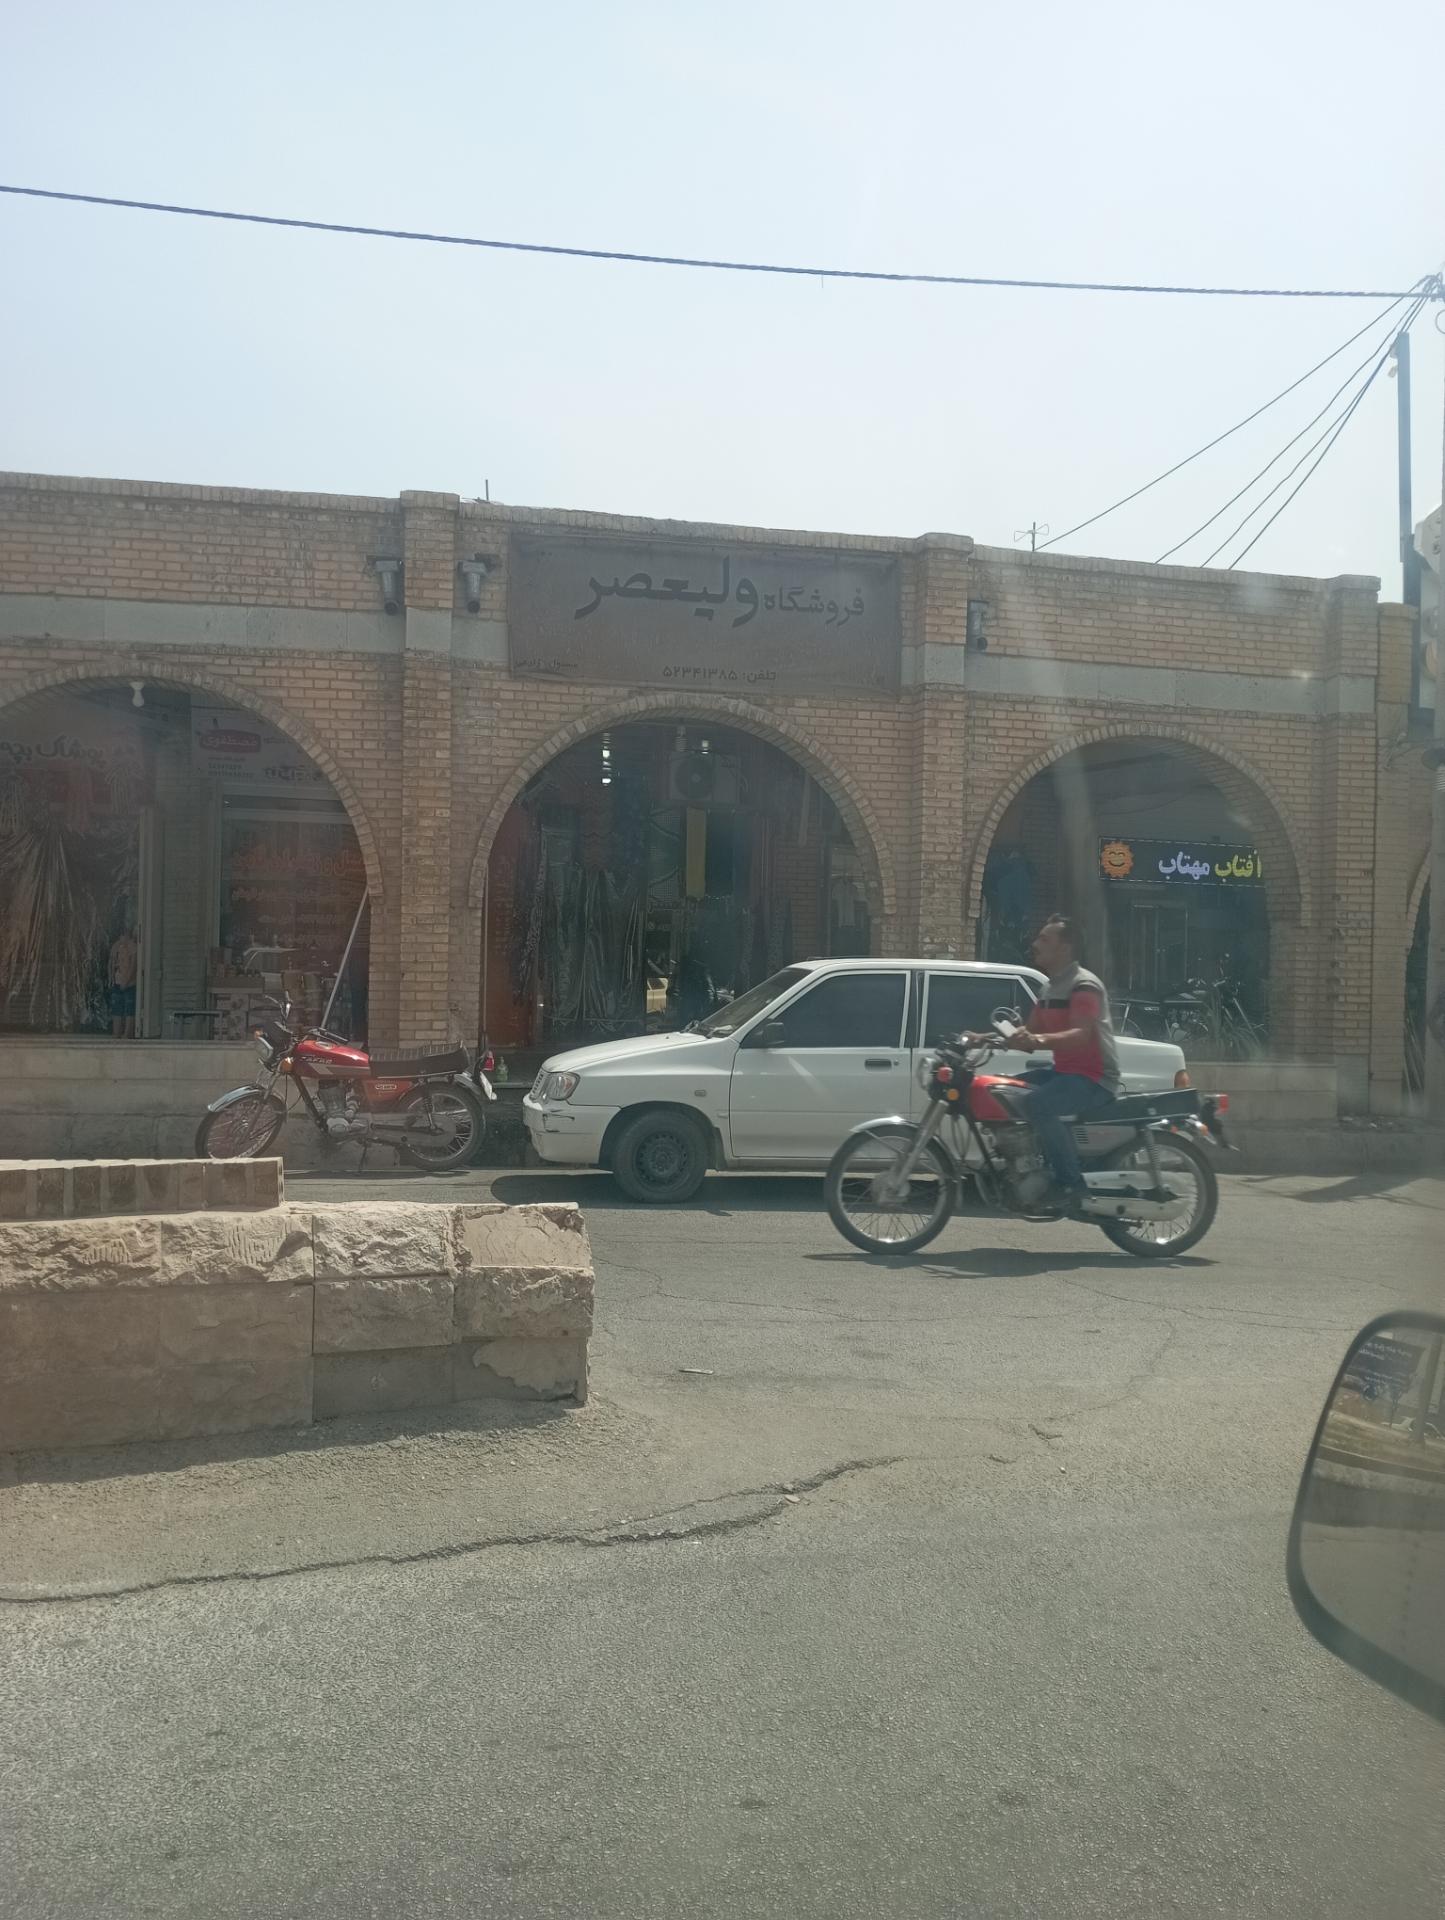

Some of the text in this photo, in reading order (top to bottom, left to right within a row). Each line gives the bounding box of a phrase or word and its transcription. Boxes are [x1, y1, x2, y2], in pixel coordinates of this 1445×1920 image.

[574, 555, 865, 628] فروشگاه ولیعصر
[35, 732, 107, 768] پوشاک
[1158, 851, 1211, 881] مهتاب
